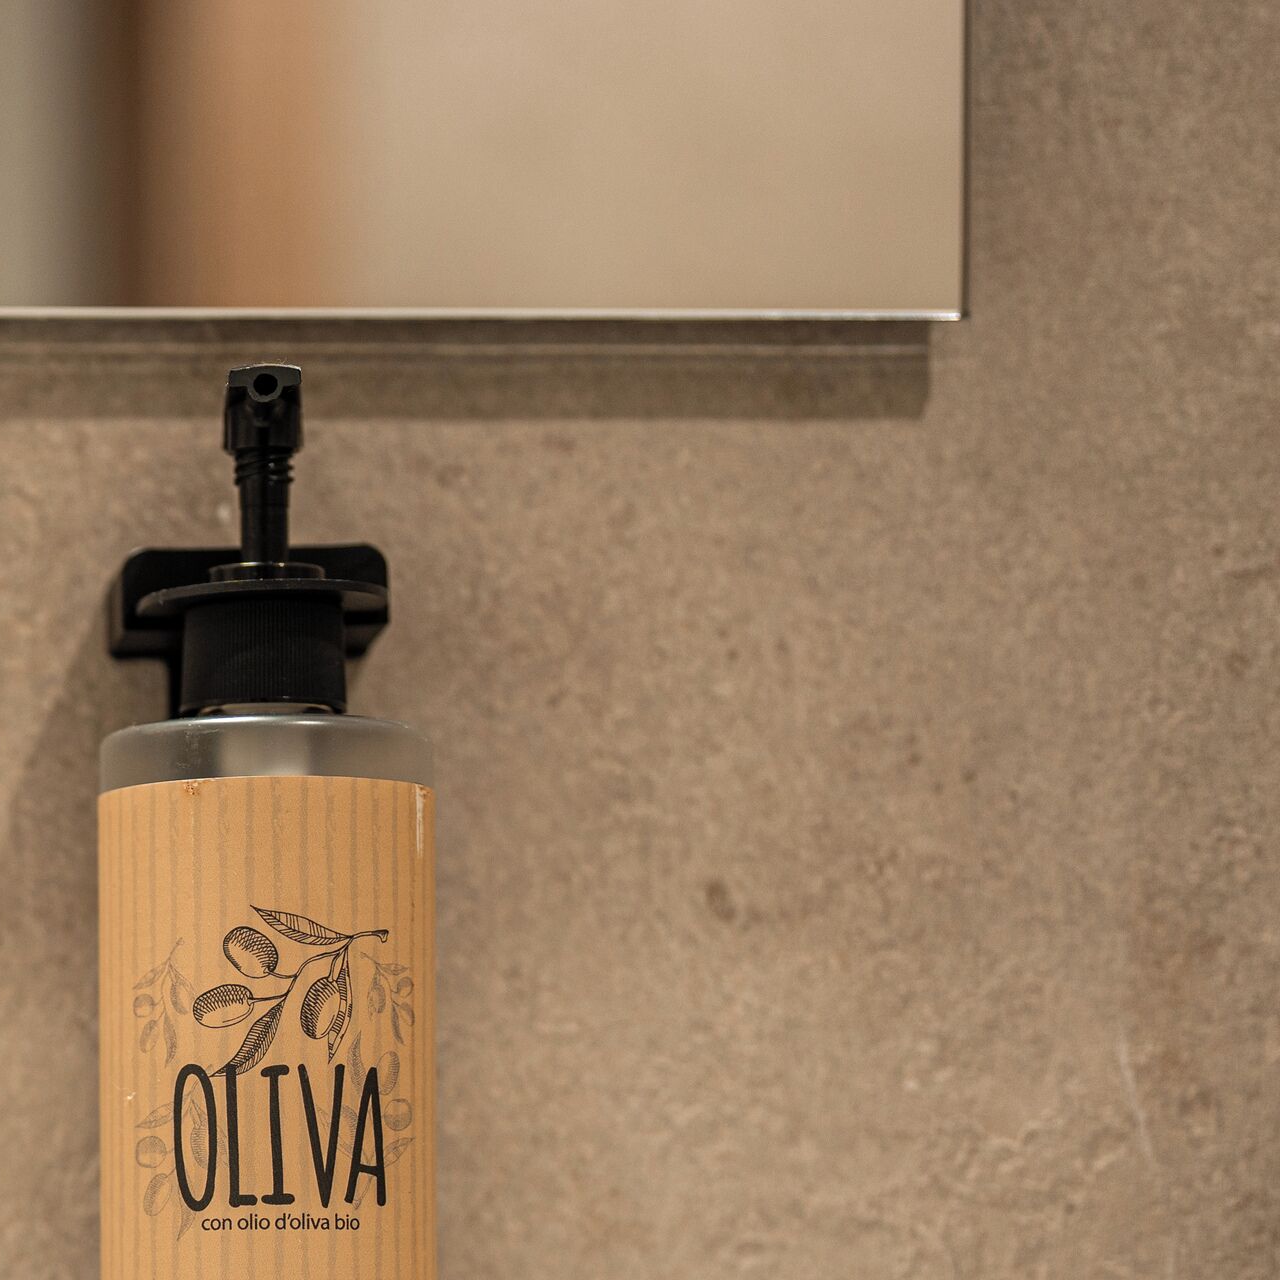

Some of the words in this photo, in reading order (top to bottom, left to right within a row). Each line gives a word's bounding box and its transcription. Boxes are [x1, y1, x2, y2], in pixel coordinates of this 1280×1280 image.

[173, 1063, 387, 1212] OLIVA
[201, 1217, 233, 1231] con
[237, 1212, 271, 1231] olio
[274, 1212, 330, 1231] d'oliva
[334, 1212, 361, 1231] bio
